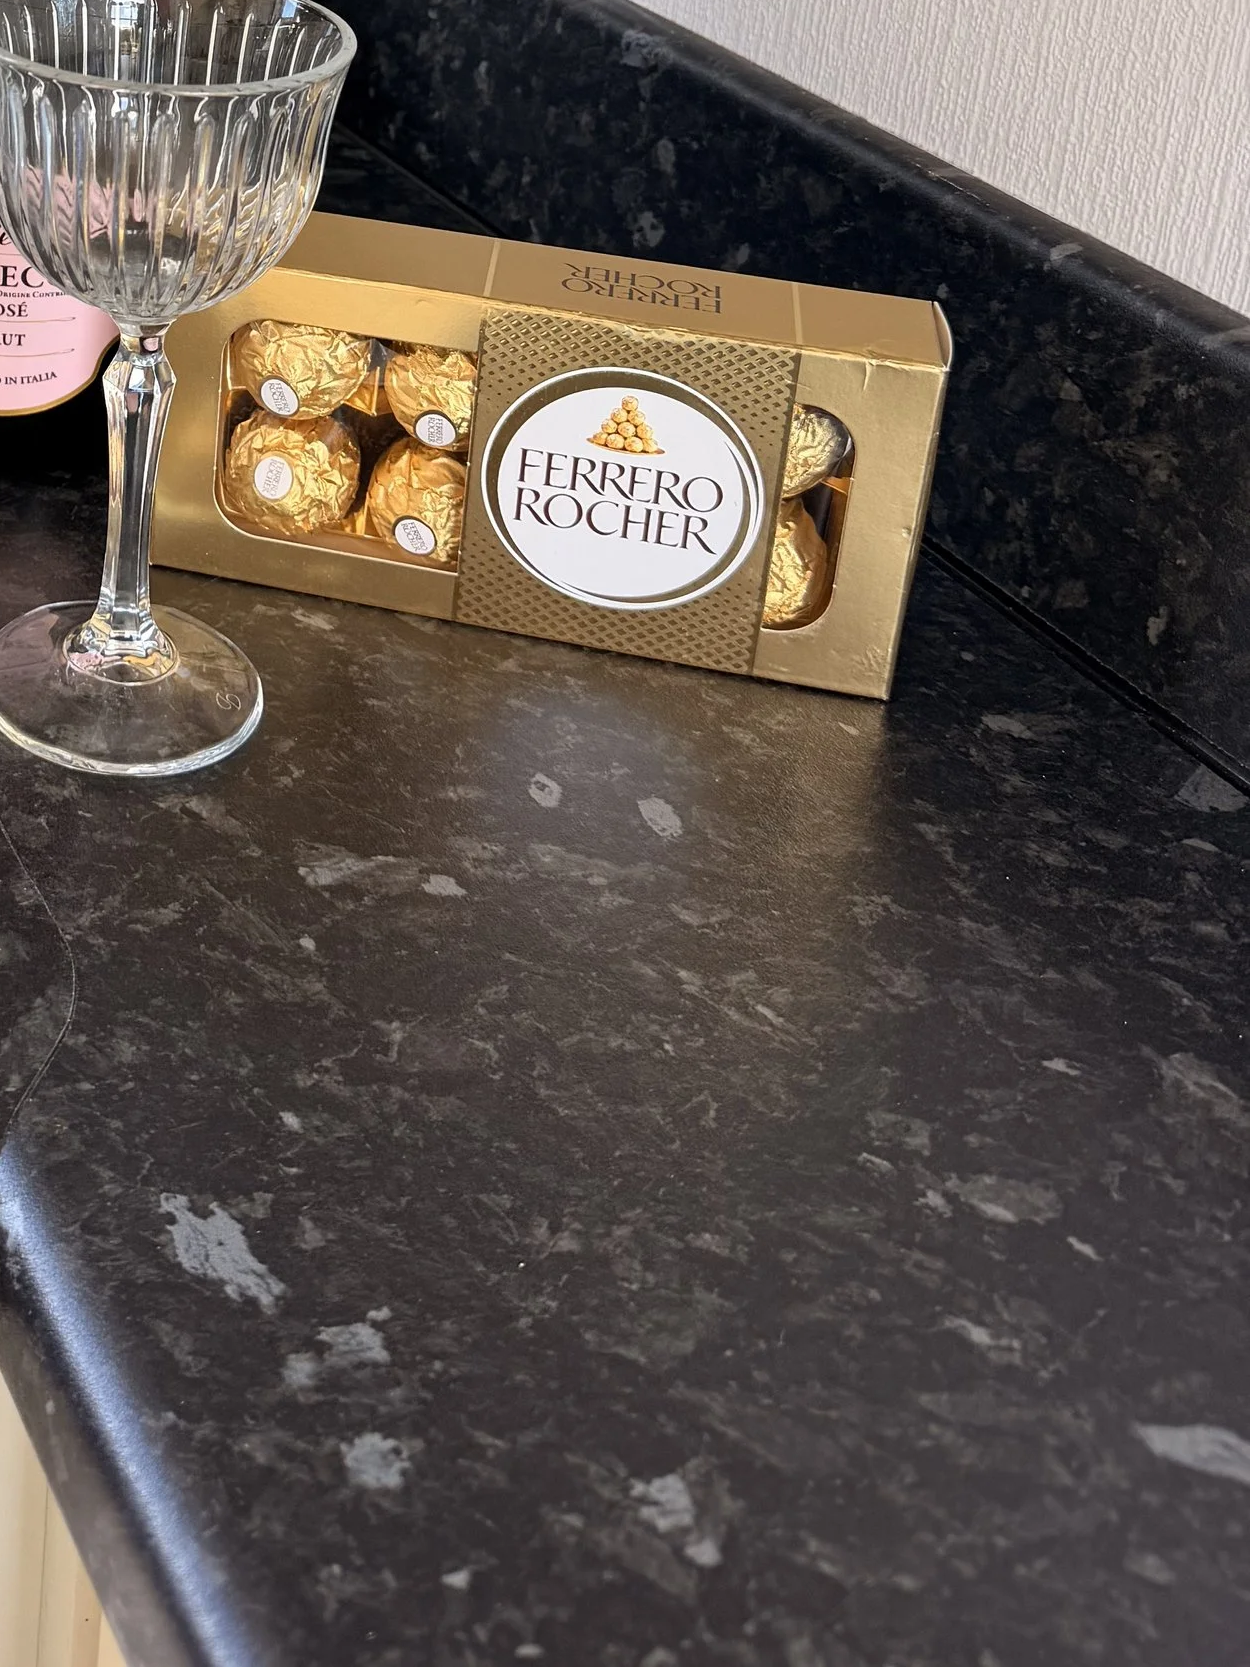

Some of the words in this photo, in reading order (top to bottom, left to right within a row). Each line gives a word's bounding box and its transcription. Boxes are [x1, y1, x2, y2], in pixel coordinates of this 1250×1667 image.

[561, 277, 721, 314] FERRERO
[563, 262, 721, 299] ROCHER
[4, 376, 18, 385] IN
[20, 371, 58, 385] ITALIA
[517, 447, 724, 512] FERRERO
[513, 486, 717, 555] ROCHER
